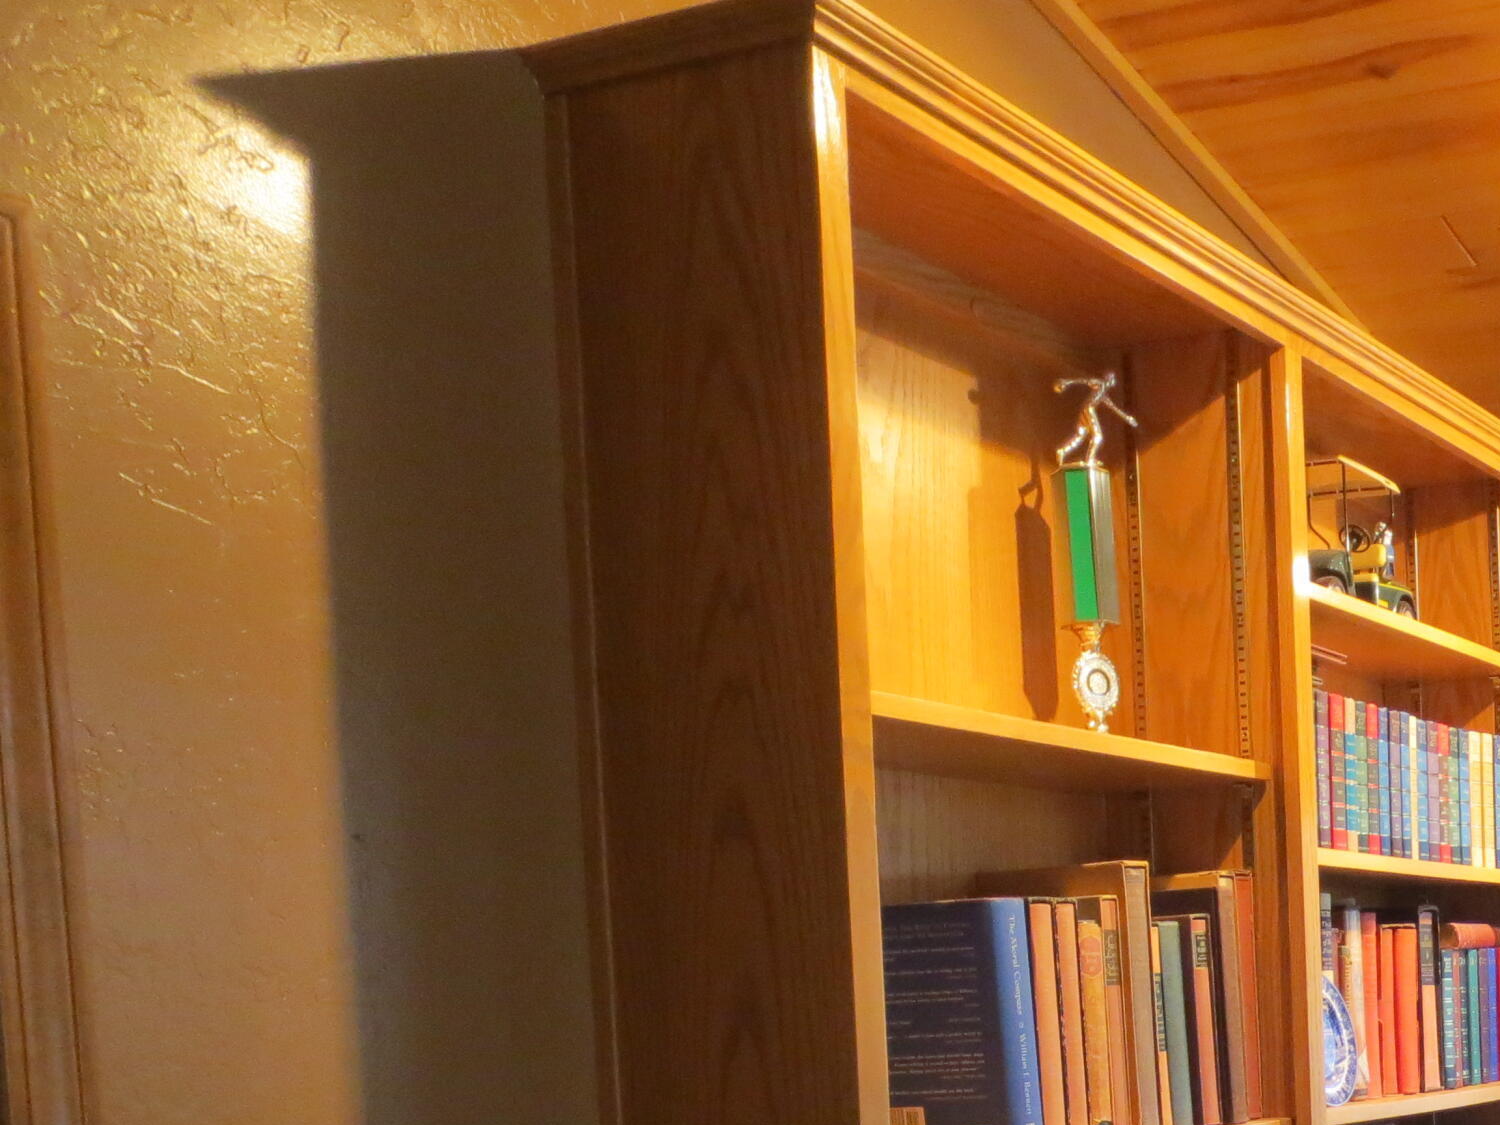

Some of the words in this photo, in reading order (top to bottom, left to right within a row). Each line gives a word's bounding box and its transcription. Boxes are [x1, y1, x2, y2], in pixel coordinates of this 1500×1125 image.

[1010, 937, 1020, 968] Moral
[1014, 971, 1023, 1015] Compass
[1019, 1033, 1028, 1069] William
